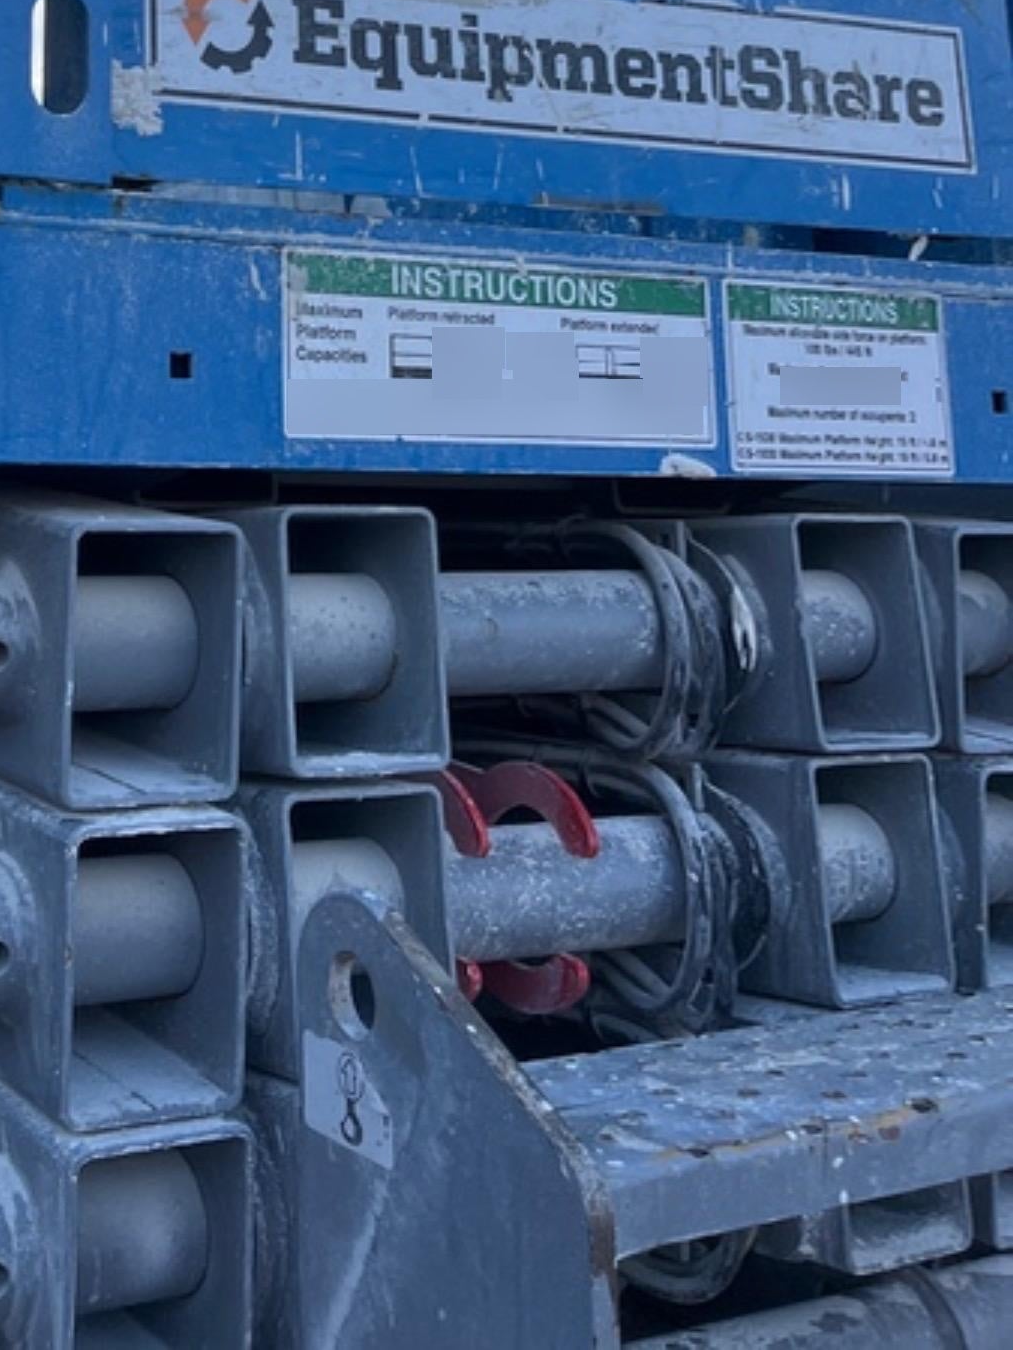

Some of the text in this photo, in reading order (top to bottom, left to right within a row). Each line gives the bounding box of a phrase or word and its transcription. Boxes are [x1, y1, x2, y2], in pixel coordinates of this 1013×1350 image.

[390, 264, 619, 309] INSTRUCTIONS
[296, 301, 363, 319] Maximum
[388, 305, 495, 326] Platform retracted
[770, 293, 899, 325] INSTRUCTIONS
[296, 324, 357, 340] Platform
[559, 317, 607, 331] Platform
[296, 345, 368, 363] Capacities
